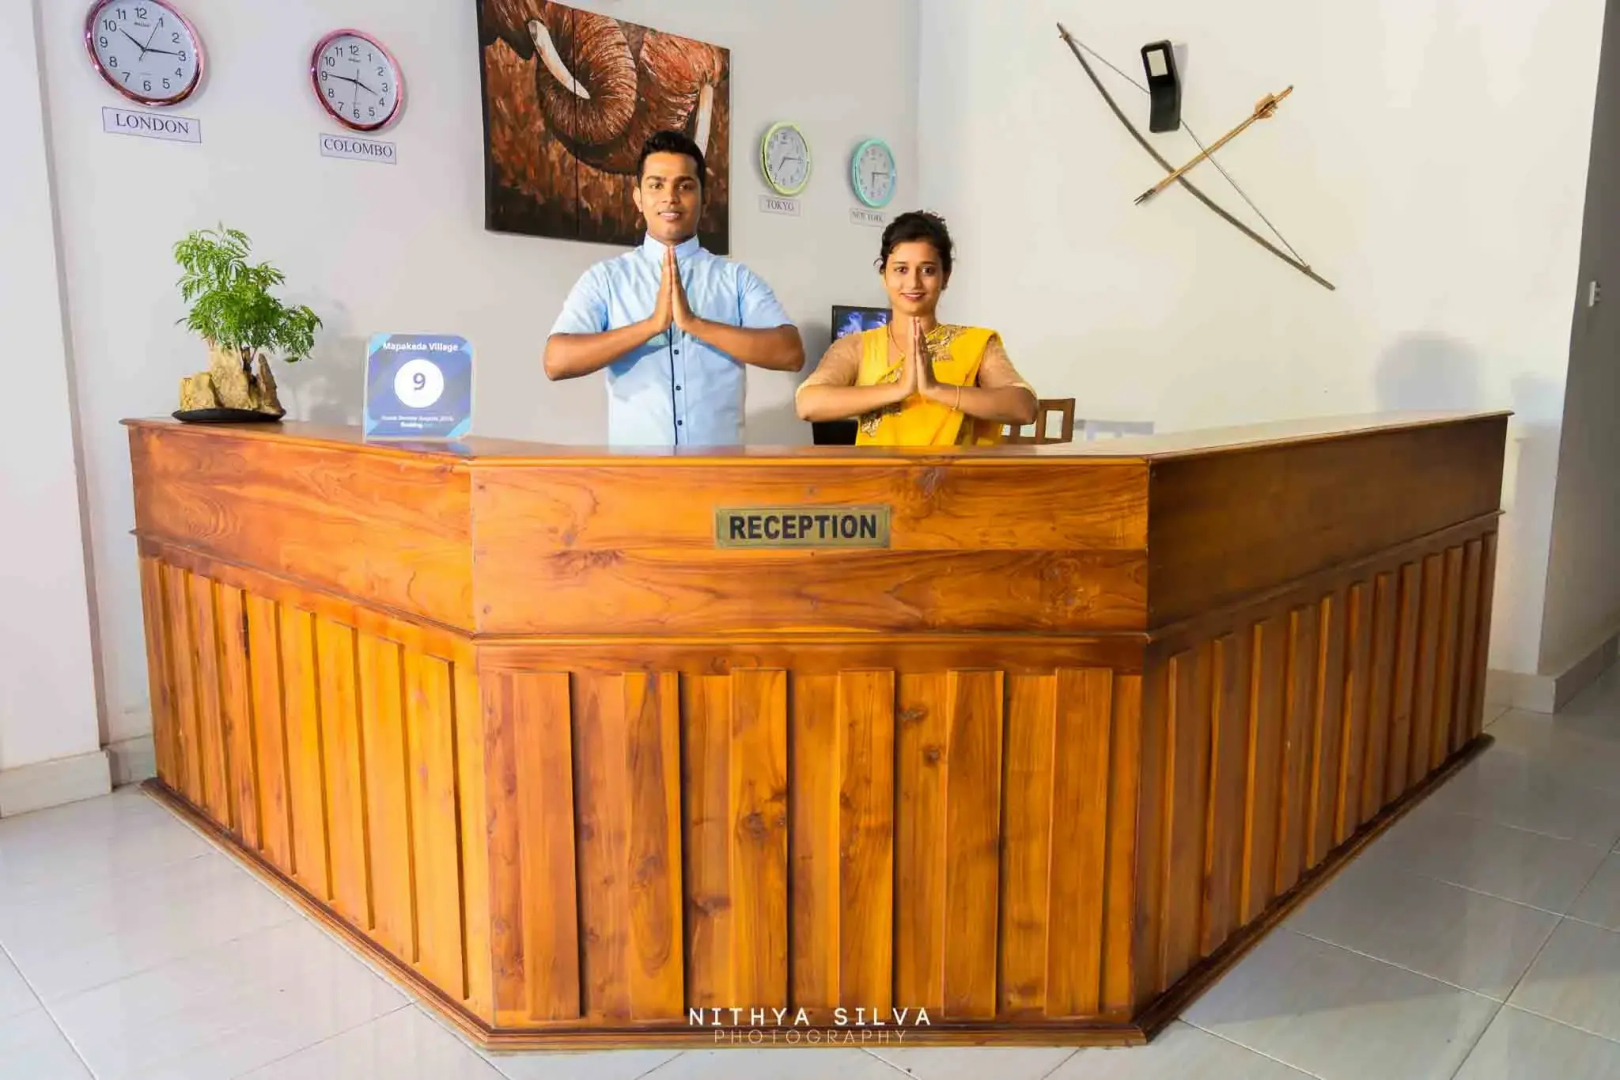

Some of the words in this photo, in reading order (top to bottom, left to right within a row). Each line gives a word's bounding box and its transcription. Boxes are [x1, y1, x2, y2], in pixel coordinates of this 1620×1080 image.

[115, 8, 127, 20] 11
[134, 7, 148, 20] 12
[103, 18, 117, 32] 10
[99, 36, 109, 48] 9
[171, 32, 181, 44] 2
[178, 50, 187, 62] 3
[334, 46, 344, 57] 11
[348, 44, 360, 56] 12
[108, 56, 118, 68] 8
[324, 56, 336, 67] 10
[367, 53, 373, 62] 1
[121, 71, 131, 82] 7
[174, 67, 183, 78] 4
[321, 70, 329, 81] 9
[376, 66, 385, 76] 2
[143, 80, 152, 92] 6
[162, 78, 171, 90] 5
[381, 82, 389, 93] 3
[327, 88, 336, 98] 8
[337, 101, 345, 111] 7
[378, 97, 386, 107] 4
[353, 108, 361, 119] 6
[368, 106, 376, 117] 5
[115, 113, 190, 134] LONDON
[323, 138, 394, 158] COLOMBO
[765, 199, 795, 211] TOKYO
[428, 342, 459, 353] Village
[412, 372, 426, 391] 9
[729, 514, 877, 540] RECEPTION
